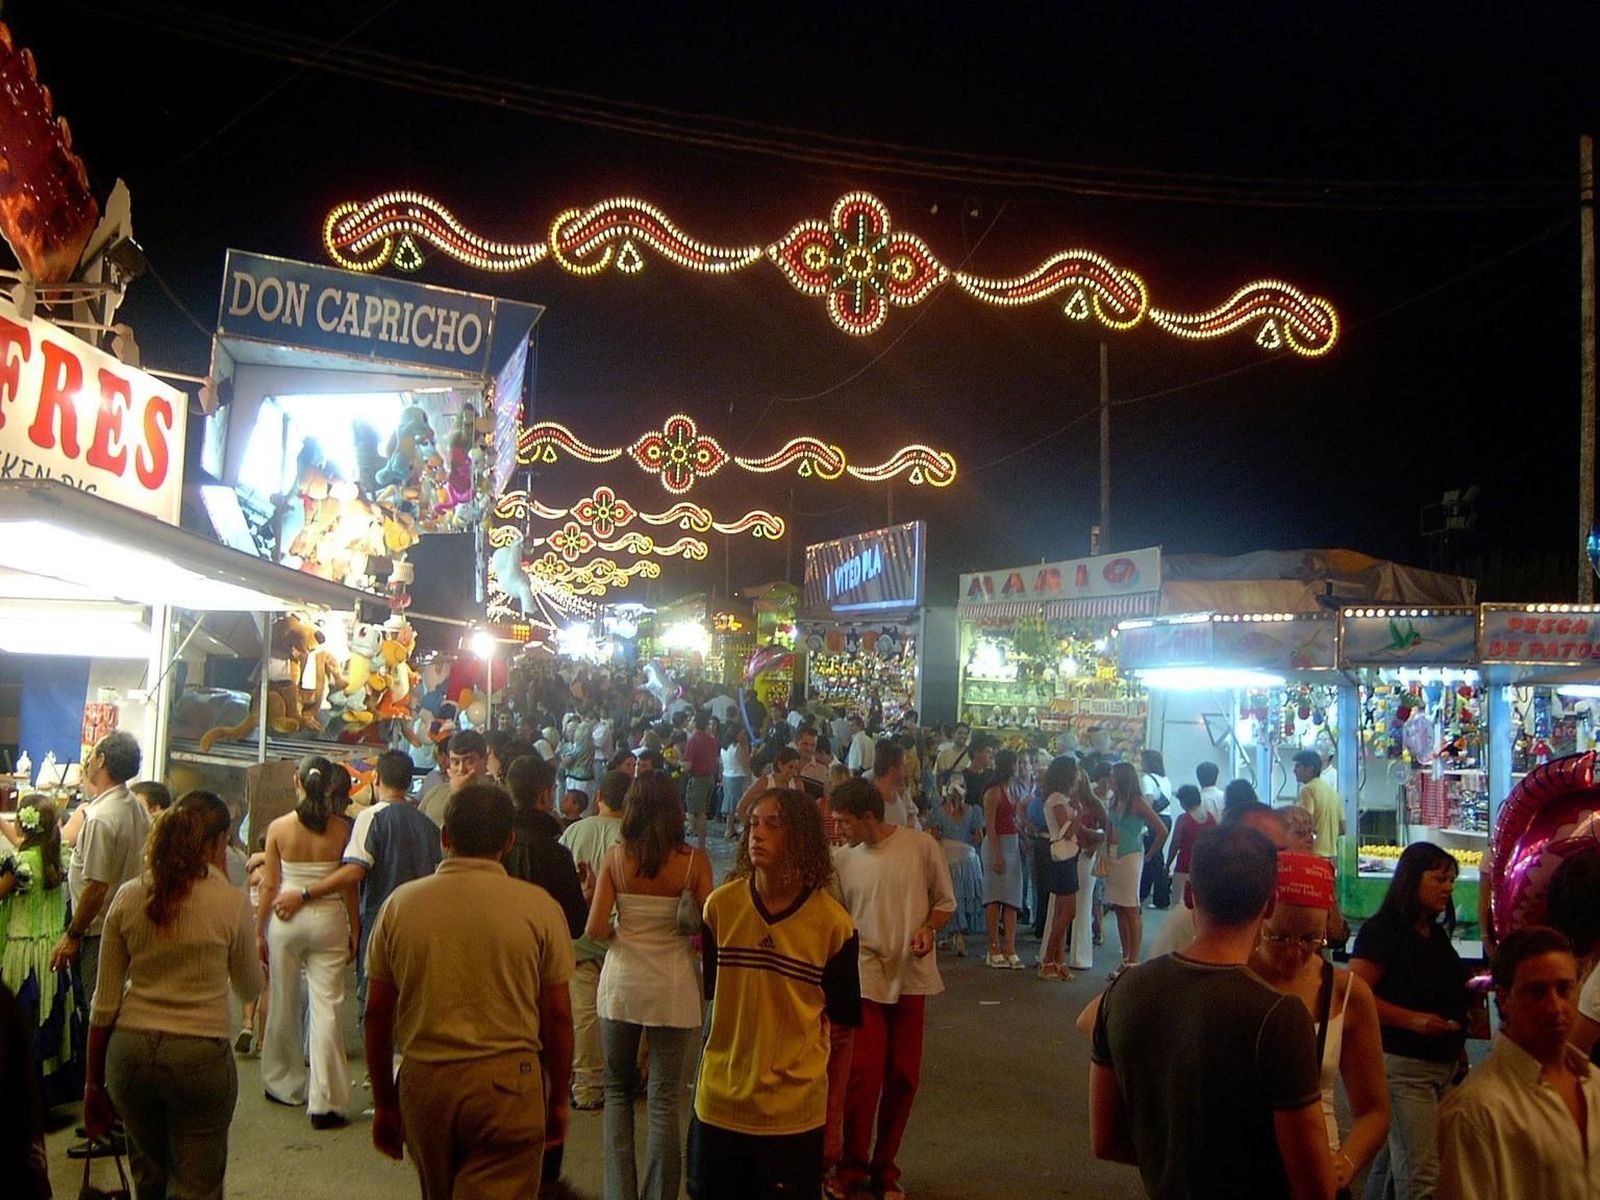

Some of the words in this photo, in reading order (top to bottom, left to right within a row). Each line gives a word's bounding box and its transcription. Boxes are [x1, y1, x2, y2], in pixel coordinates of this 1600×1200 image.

[228, 270, 310, 328] DON
[315, 287, 483, 356] CAPRICHO
[966, 556, 1138, 598] MARIO
[1506, 616, 1589, 635] PESCA
[1487, 640, 1522, 657] DE
